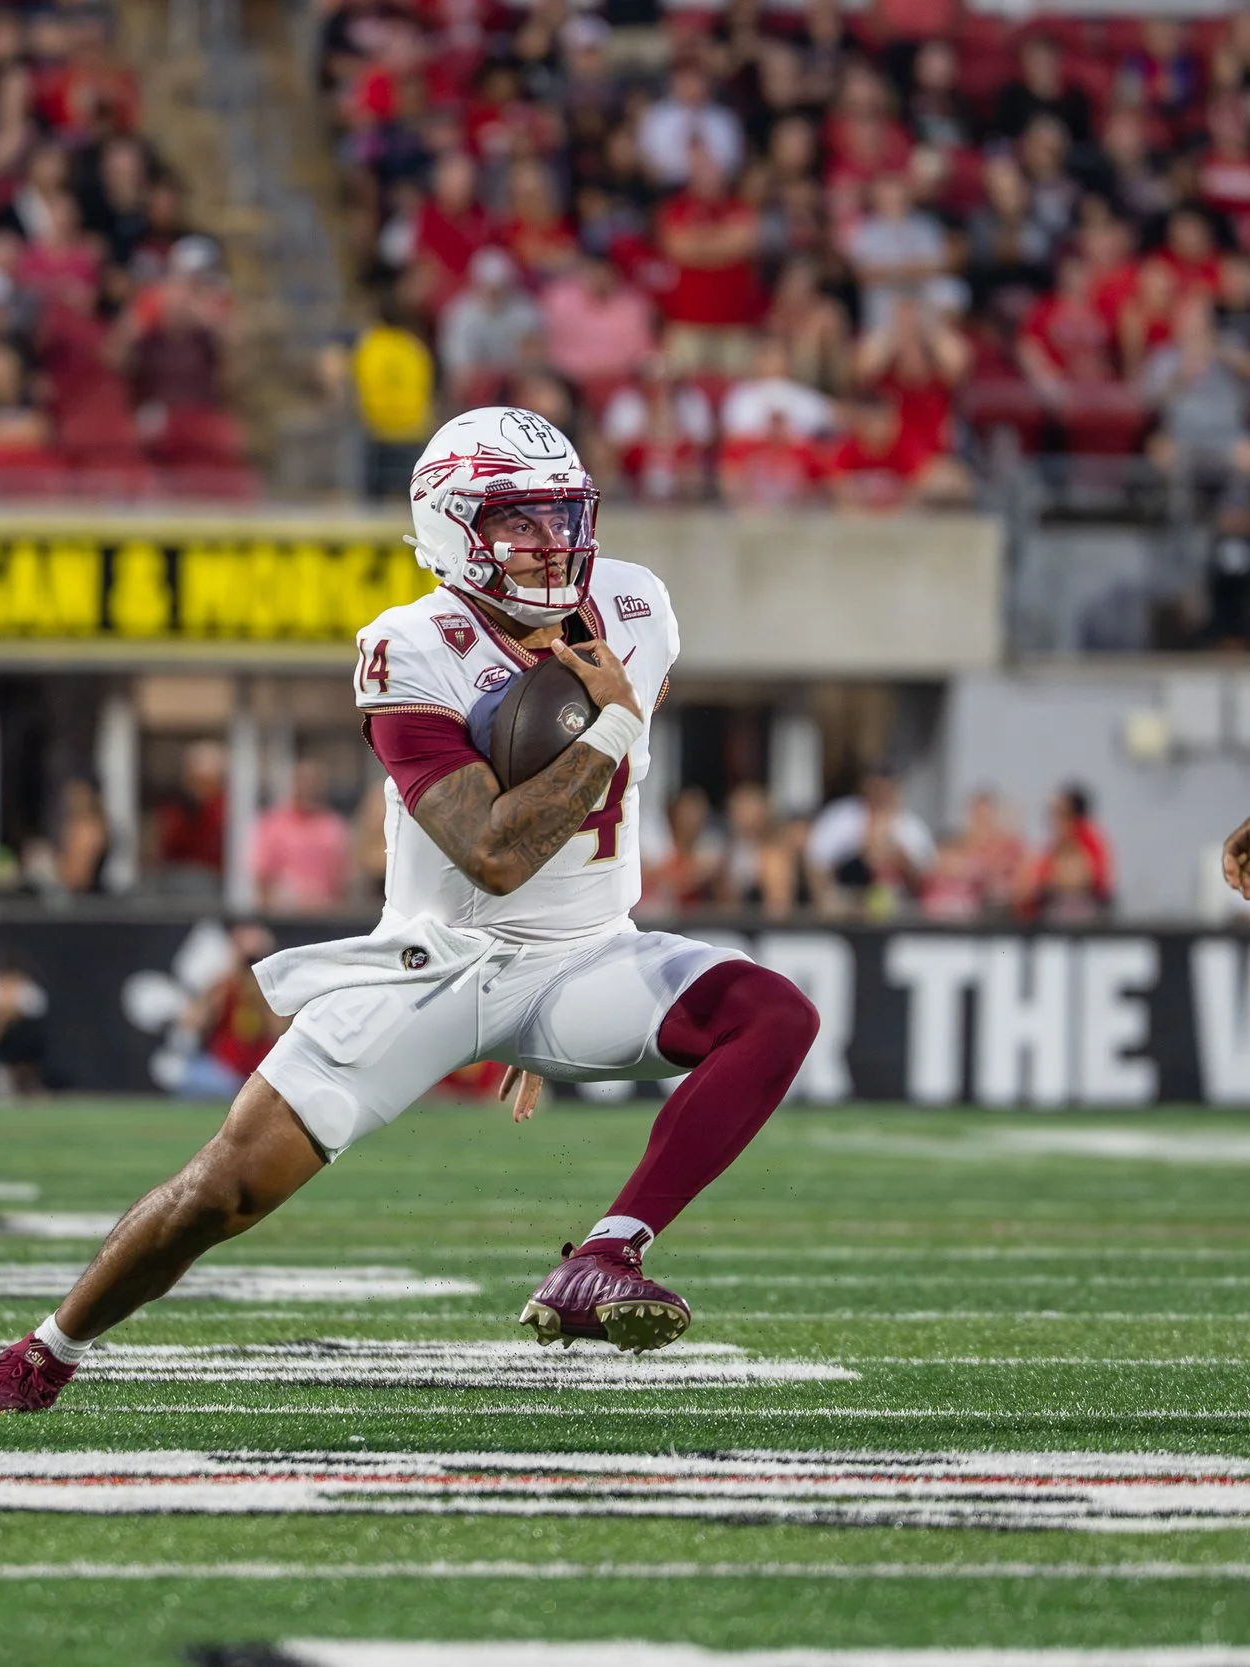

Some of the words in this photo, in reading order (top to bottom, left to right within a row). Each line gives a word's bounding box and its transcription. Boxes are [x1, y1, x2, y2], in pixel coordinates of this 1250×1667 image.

[544, 472, 570, 484] ACC
[358, 638, 391, 696] 14
[481, 668, 506, 686] ACC
[884, 935, 1160, 1107] THE
